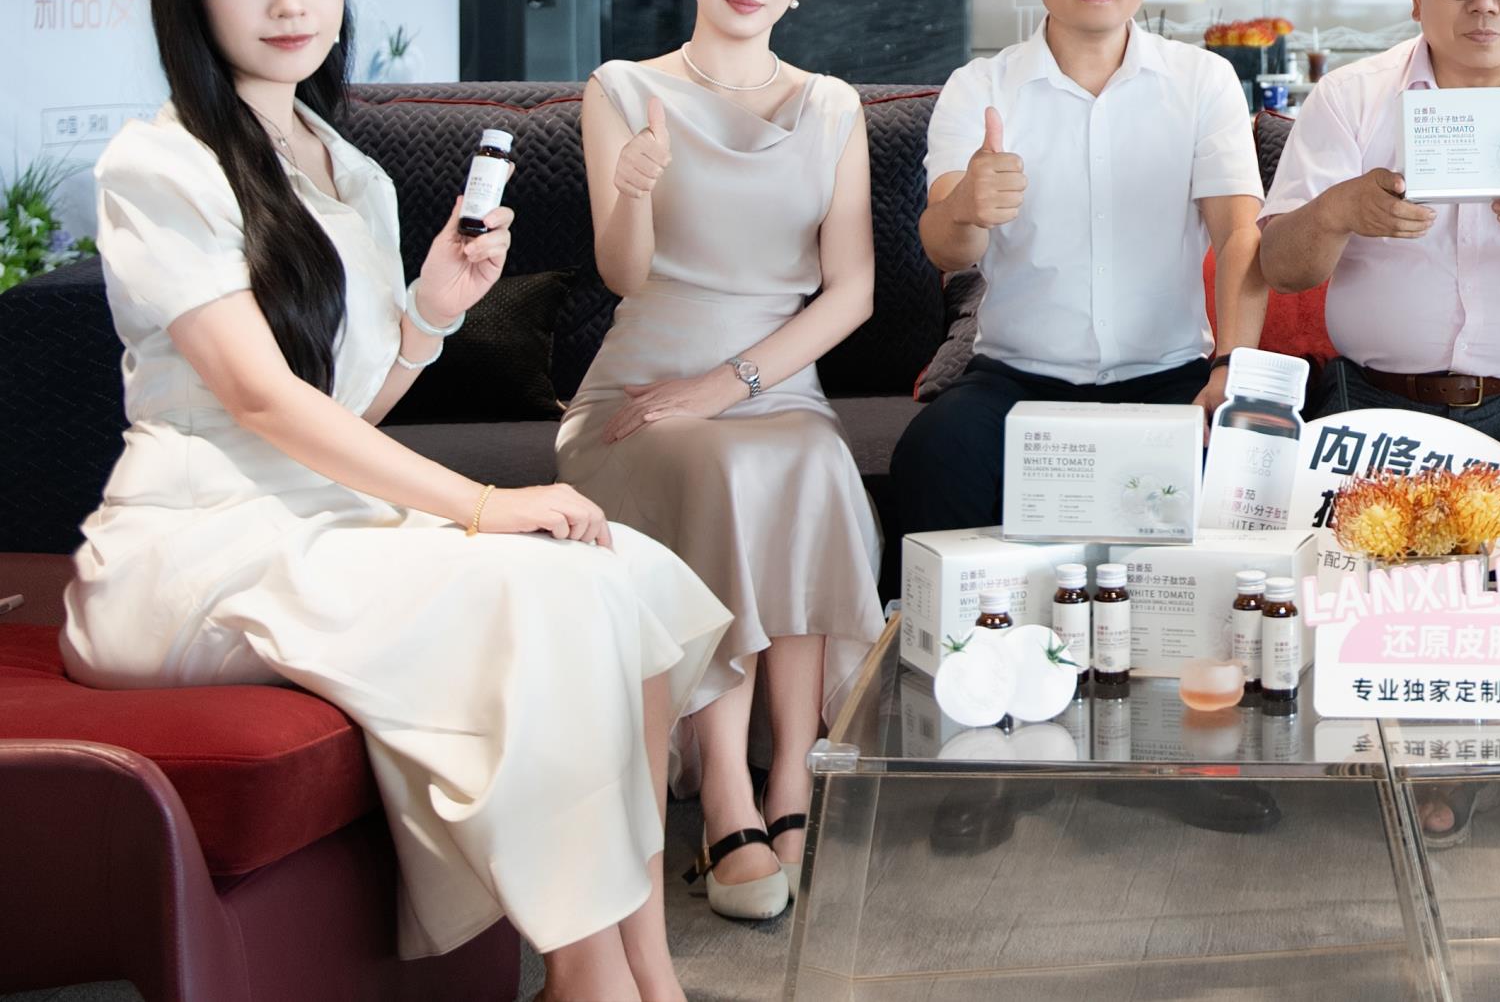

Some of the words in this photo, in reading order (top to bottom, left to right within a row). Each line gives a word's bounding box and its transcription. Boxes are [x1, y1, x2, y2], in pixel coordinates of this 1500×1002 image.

[1414, 126, 1440, 134] WHITE
[1442, 125, 1475, 134] TOMATO
[1024, 432, 1052, 441] 白番茄
[1024, 443, 1097, 453] 胶原小分子肽饮品
[1023, 457, 1054, 465] WHITE
[1057, 458, 1096, 467] TOMATO
[1128, 590, 1155, 598] WHITE
[1158, 591, 1196, 600] TOMATO
